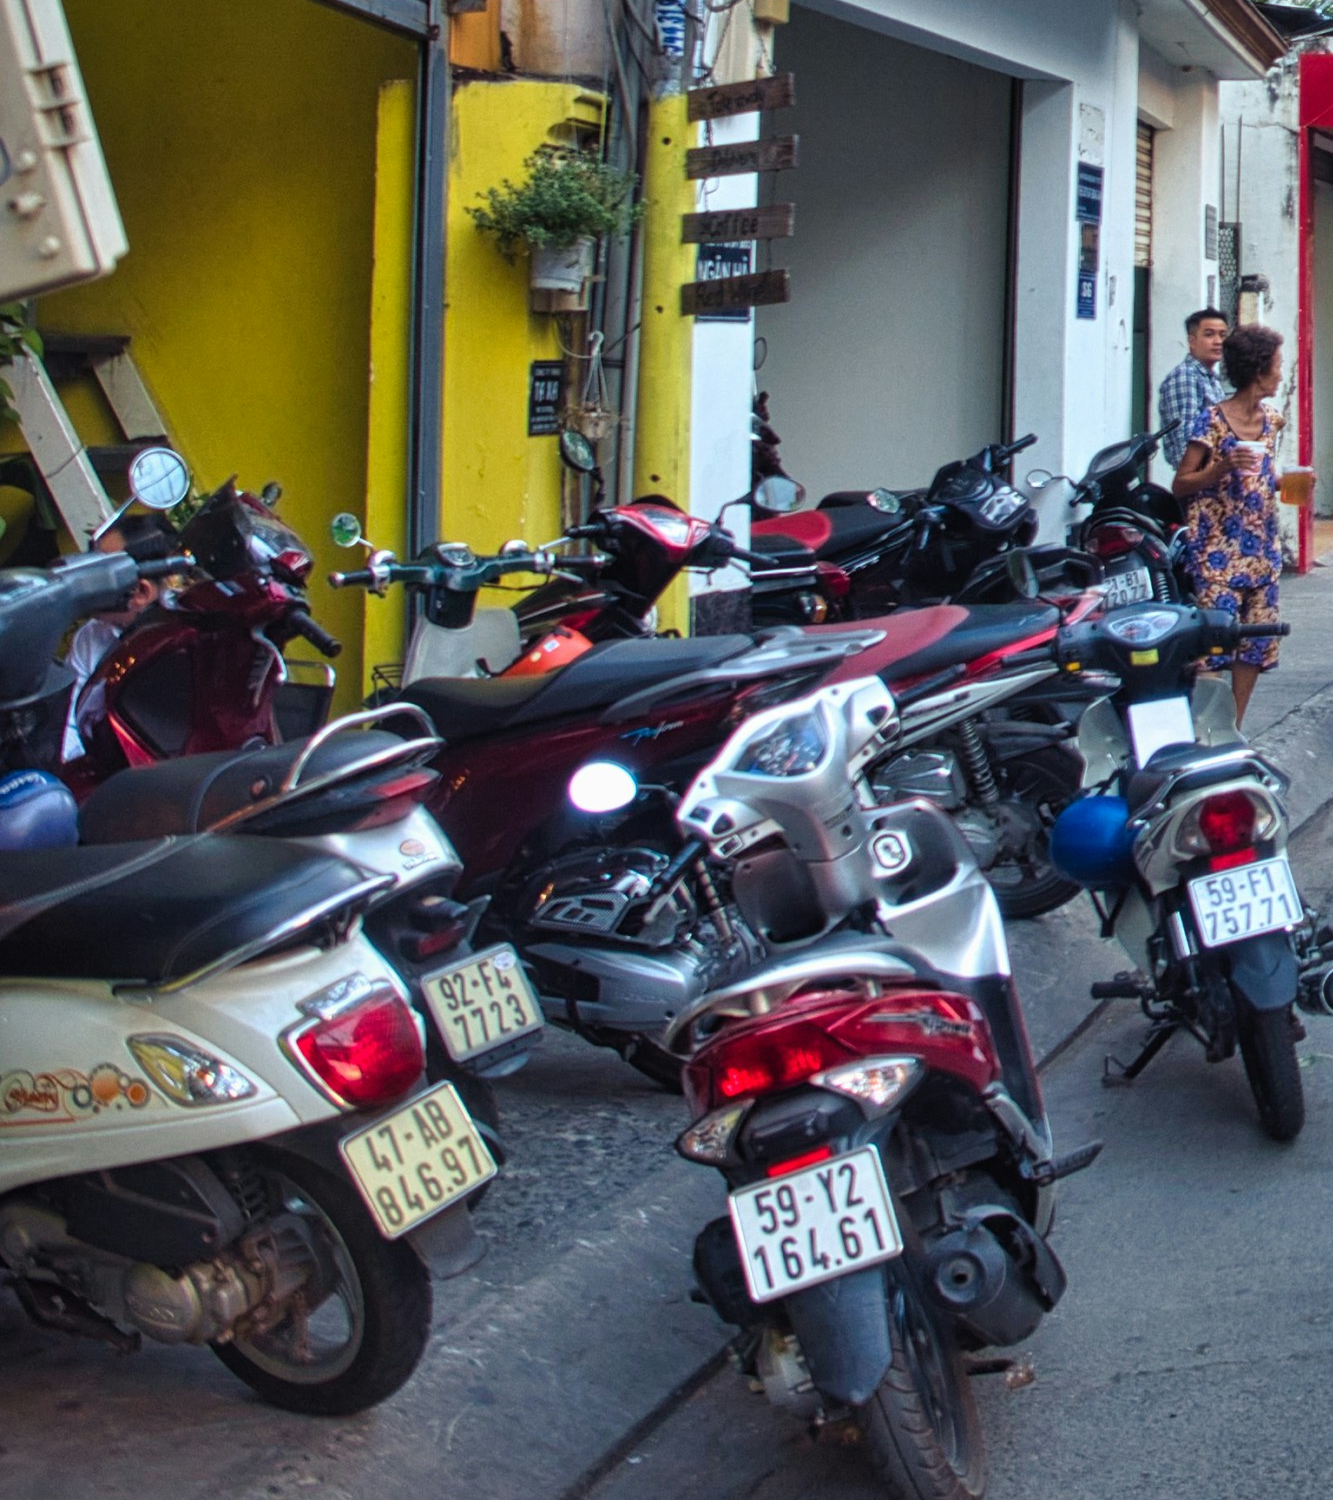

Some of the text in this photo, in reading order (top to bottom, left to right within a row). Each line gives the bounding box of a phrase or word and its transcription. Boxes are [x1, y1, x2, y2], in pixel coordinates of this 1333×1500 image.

[1204, 892, 1294, 941] 757.71
[1205, 866, 1277, 908] 59-F1
[438, 960, 513, 1012] 92-F4
[453, 993, 528, 1050] 7723
[365, 1099, 454, 1172] 47-AB
[376, 1134, 483, 1227] 846.97
[753, 1162, 866, 1235] 59-Y2
[753, 1206, 886, 1290] 164.61
